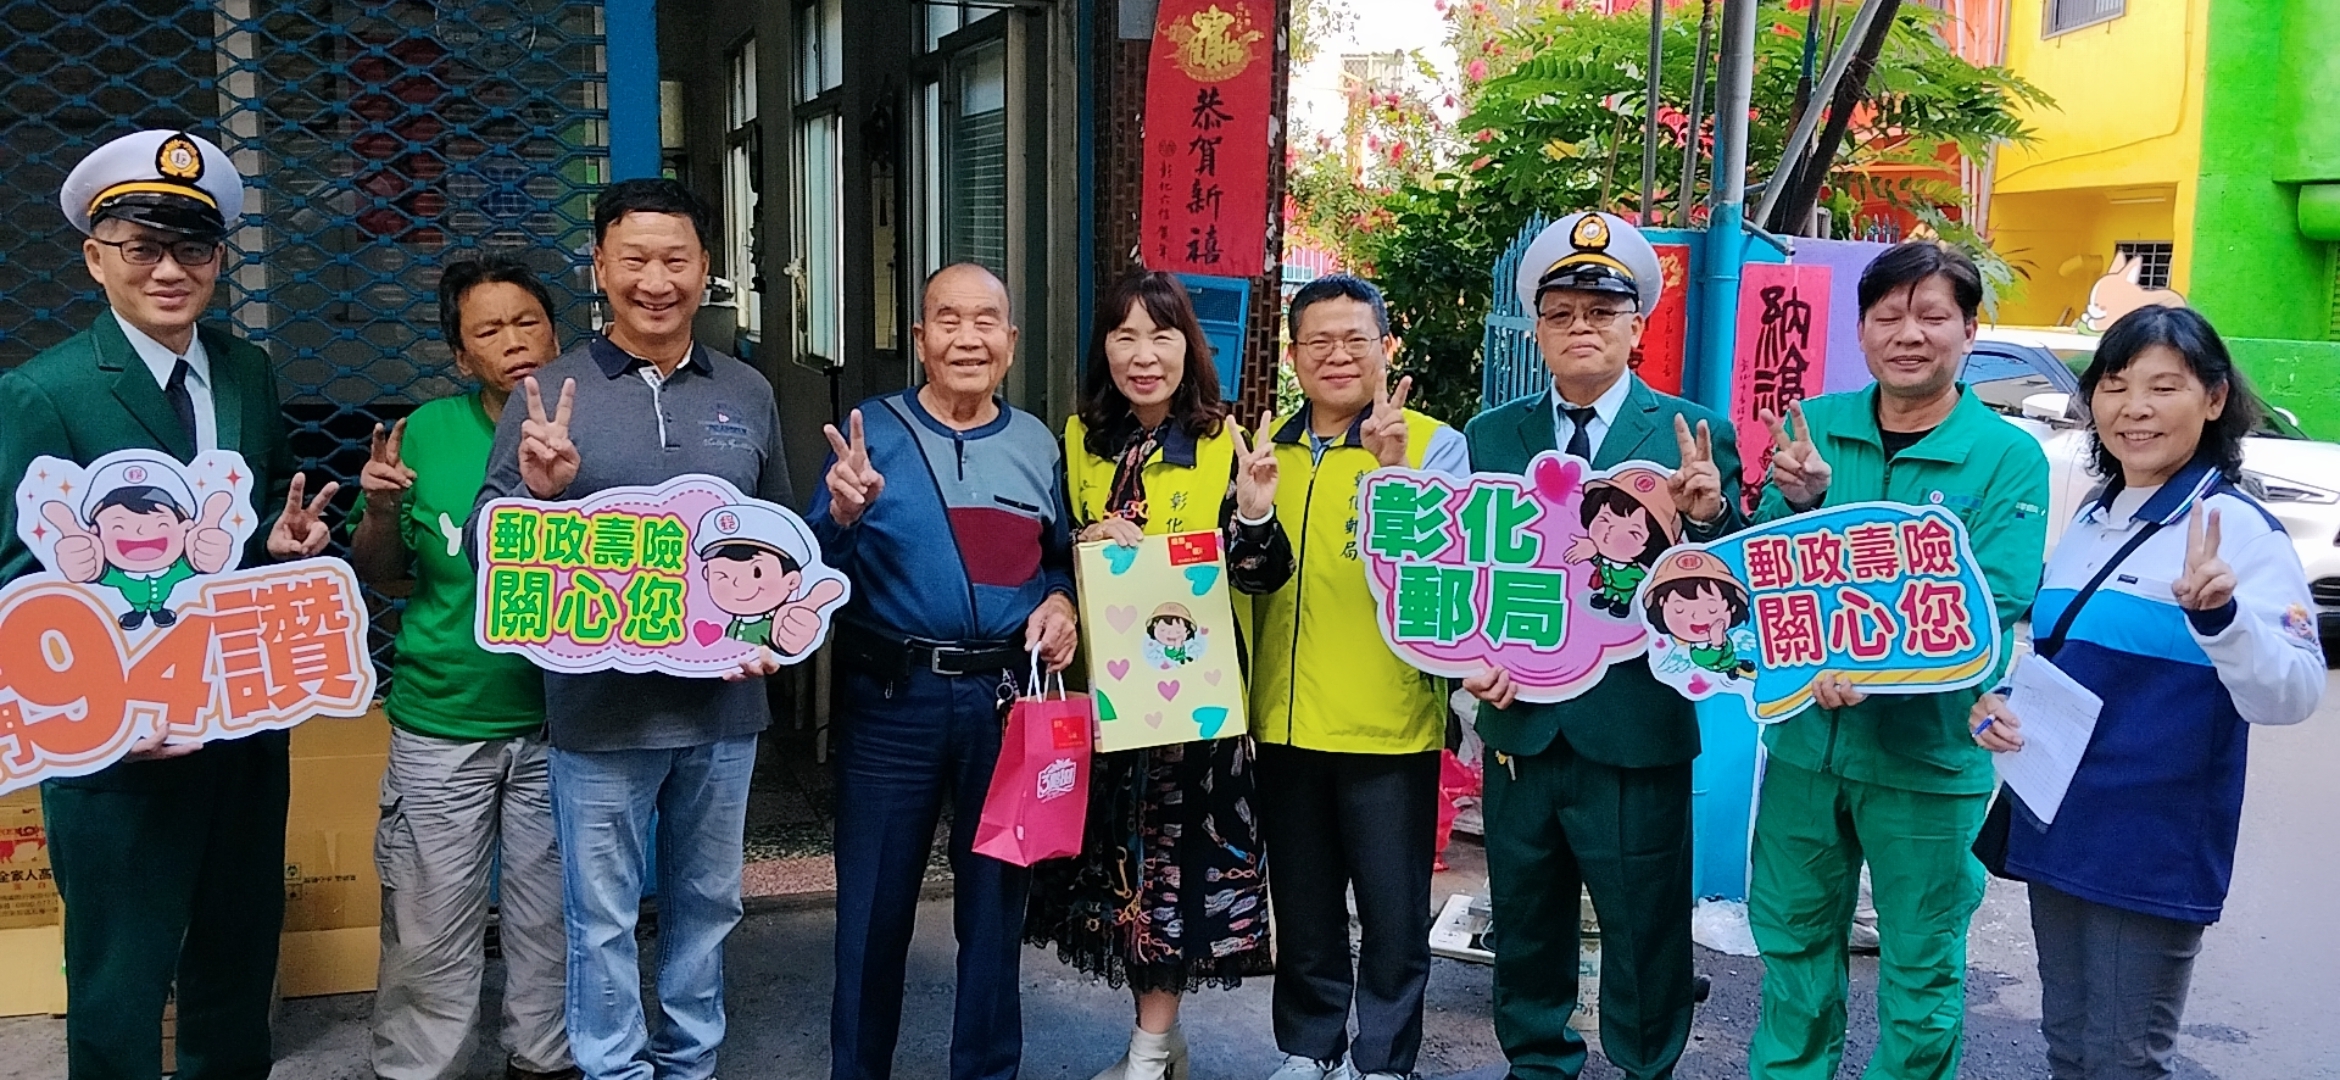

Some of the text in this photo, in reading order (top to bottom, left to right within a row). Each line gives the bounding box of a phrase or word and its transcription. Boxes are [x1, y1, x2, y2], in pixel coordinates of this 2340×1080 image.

[1186, 86, 1235, 264] 恭賀新禧
[493, 511, 687, 570] 郵政壽險
[1166, 491, 1188, 533] 彰化
[1371, 482, 1540, 564] 彰化
[1748, 520, 1957, 589] 郵政壽險
[490, 569, 683, 641] 關心您
[1398, 566, 1564, 648] 郵局
[1757, 583, 1972, 665] 關心您
